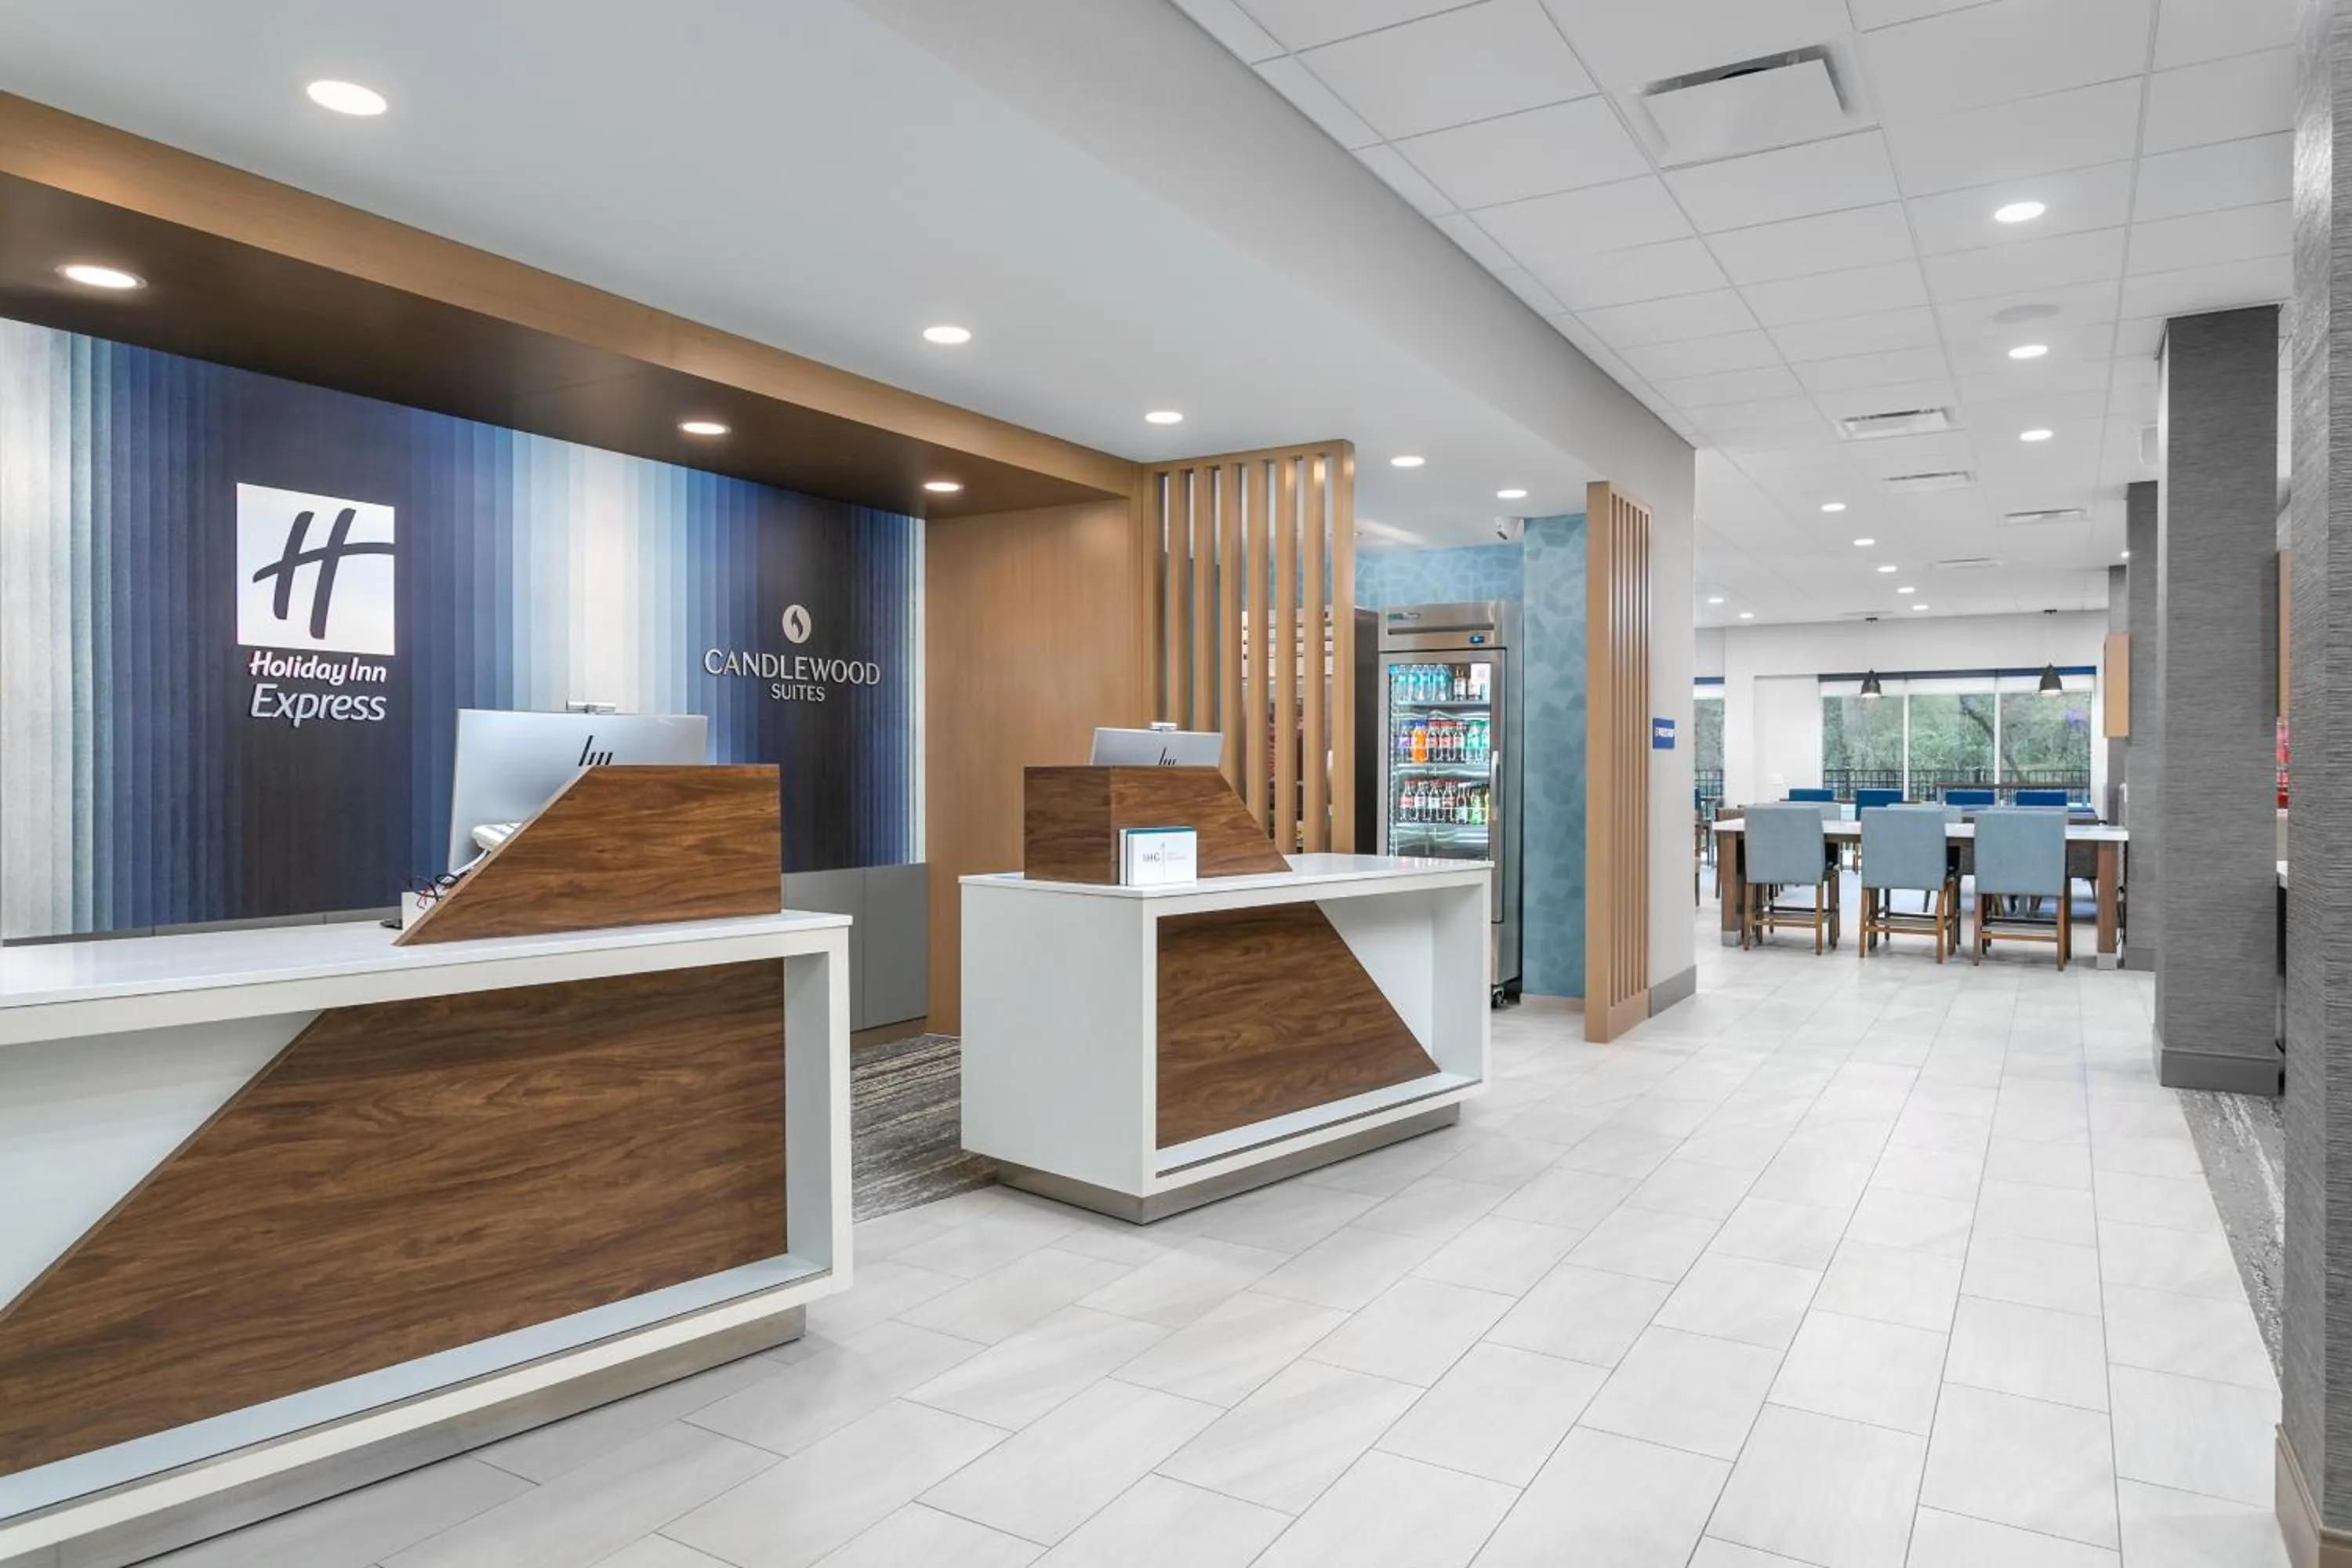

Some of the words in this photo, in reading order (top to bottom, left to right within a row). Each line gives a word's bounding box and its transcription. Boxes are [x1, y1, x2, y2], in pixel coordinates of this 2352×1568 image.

[249, 651, 347, 684] Holiday
[350, 657, 387, 683] Inn
[704, 648, 880, 685] CANDLEWOOD
[250, 683, 387, 728] Express
[771, 683, 826, 702] SUITES
[1142, 851, 1161, 863] IHG
